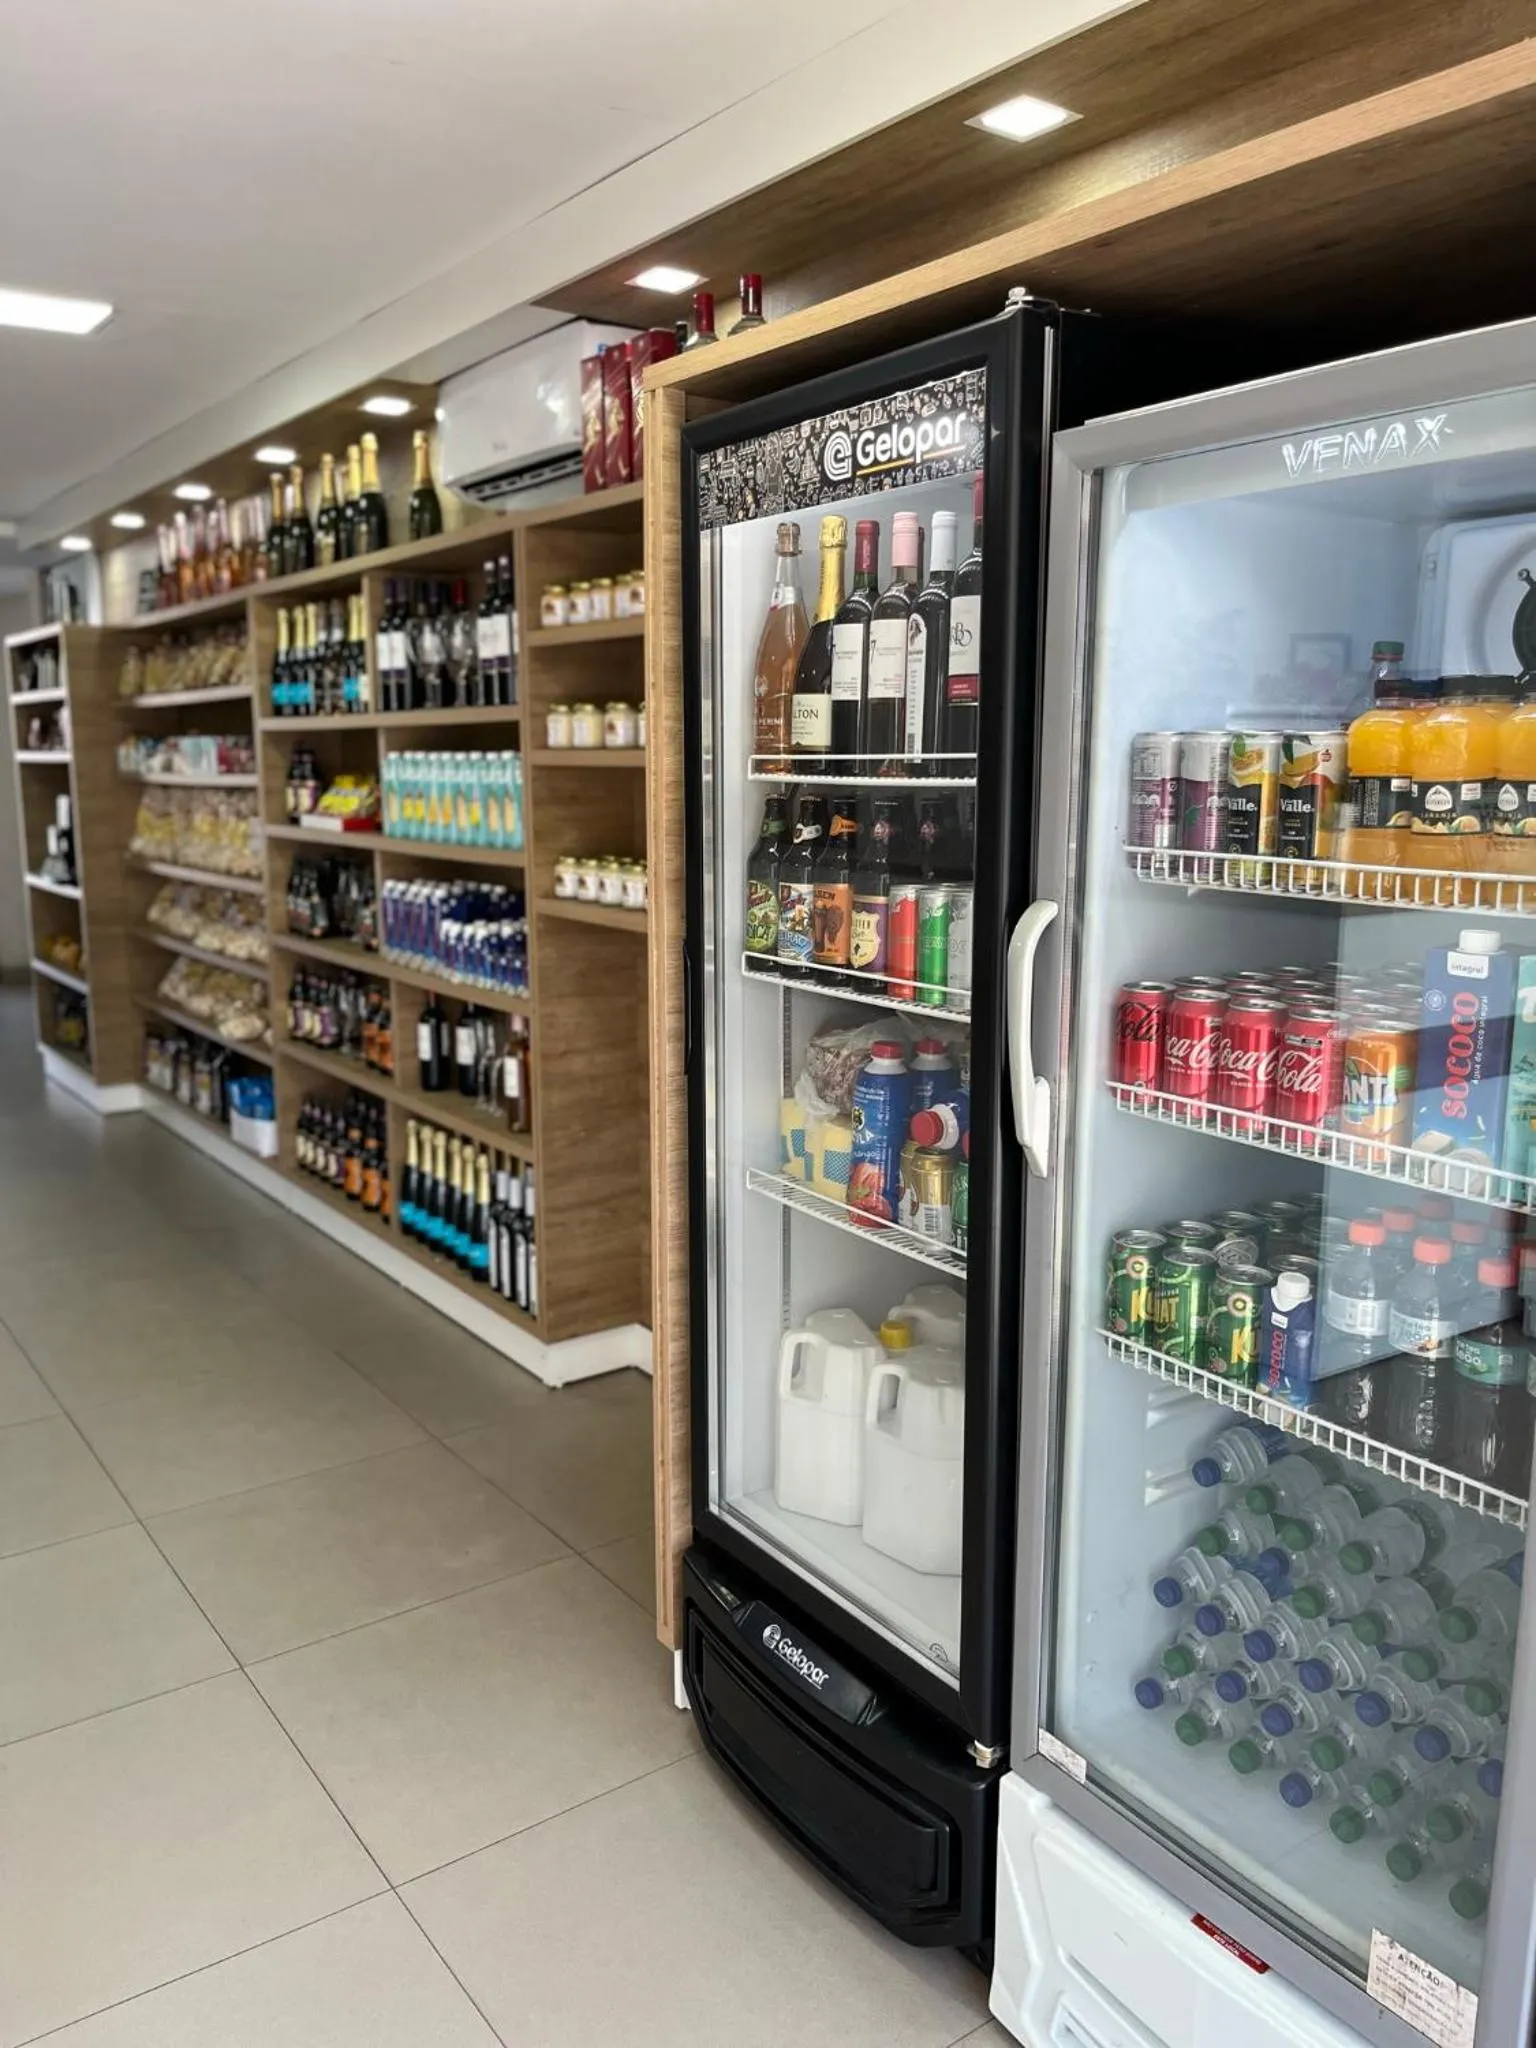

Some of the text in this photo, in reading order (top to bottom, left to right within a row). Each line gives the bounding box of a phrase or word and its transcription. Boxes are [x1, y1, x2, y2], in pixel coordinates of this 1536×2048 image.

[856, 411, 967, 466] Gelopar
[1281, 413, 1449, 478] VENAX
[1441, 991, 1479, 1119] SOCOCO
[778, 1637, 830, 1685] Gelopar
